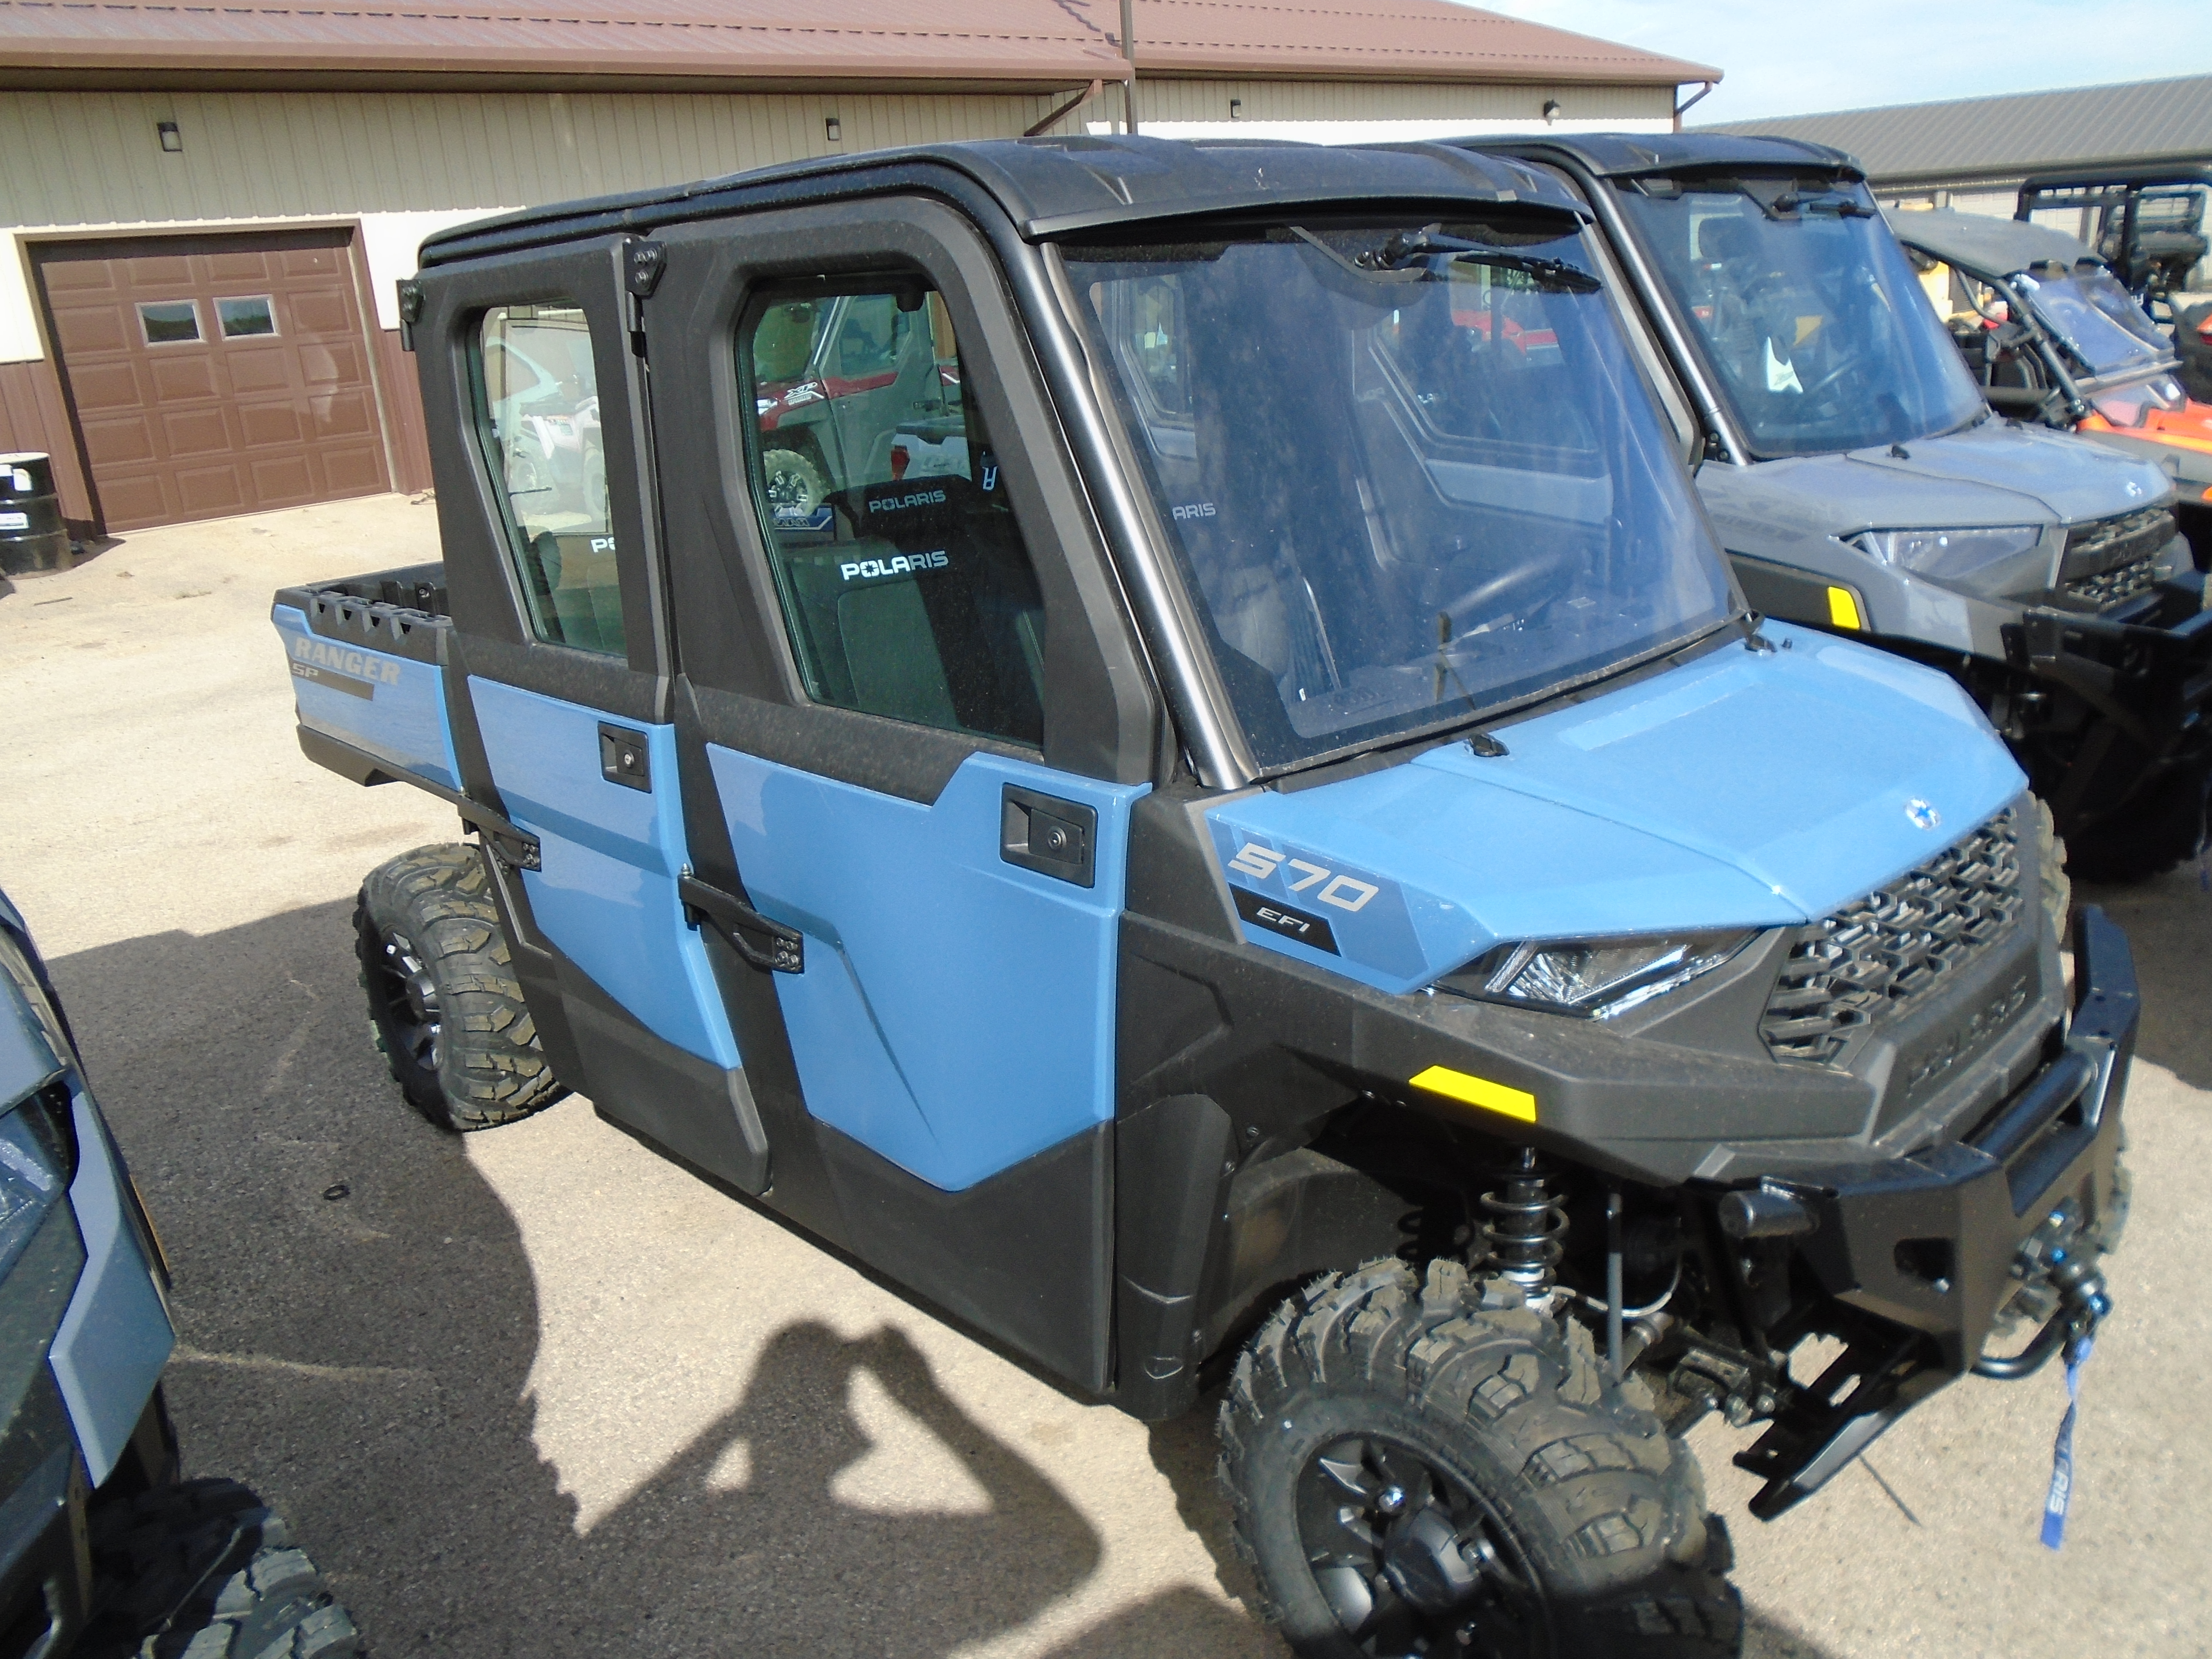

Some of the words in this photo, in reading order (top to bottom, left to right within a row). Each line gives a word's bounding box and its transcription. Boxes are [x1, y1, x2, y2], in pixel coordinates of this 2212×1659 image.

[868, 490, 946, 513] POLARIS
[840, 550, 948, 580] POLARIS
[292, 662, 319, 678] SP
[295, 637, 401, 686] RANGER
[1228, 842, 1379, 912] 570
[1256, 907, 1310, 932] EFI
